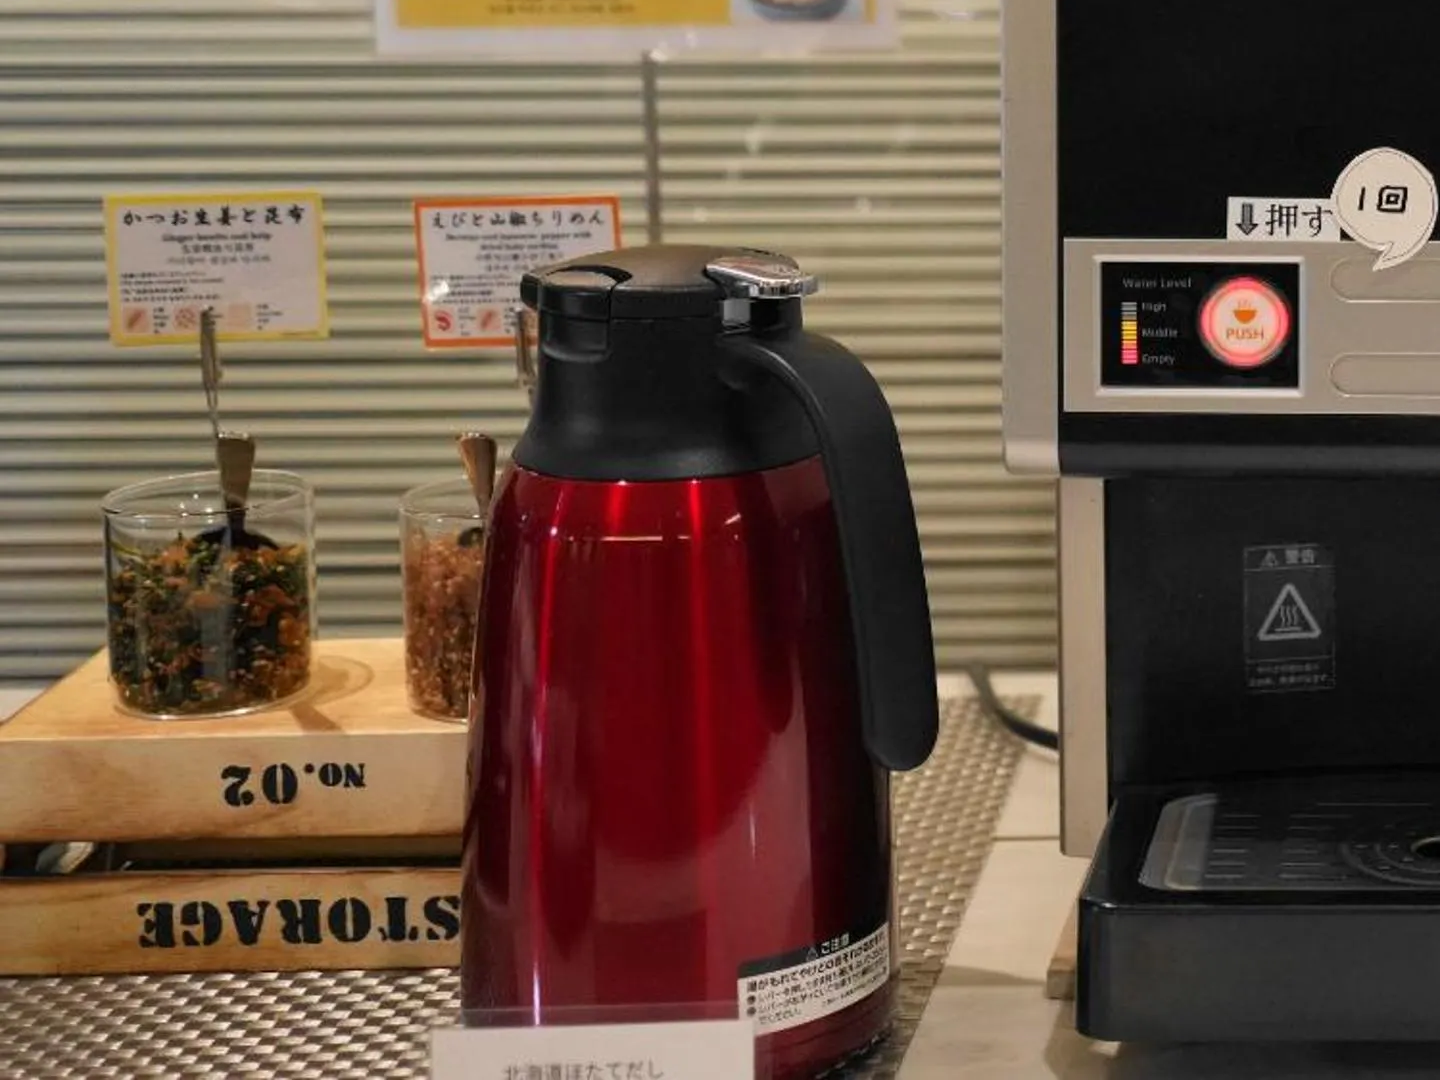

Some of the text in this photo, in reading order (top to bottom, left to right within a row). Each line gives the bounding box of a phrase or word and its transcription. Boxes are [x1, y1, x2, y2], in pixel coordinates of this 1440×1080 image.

[123, 204, 305, 226] かつお生姜と昆布
[1265, 203, 1333, 237] 押す
[1122, 276, 1192, 289] Water Level
[1141, 301, 1167, 313] High
[1141, 327, 1179, 338] Middle
[1225, 327, 1264, 341] PUSH
[1141, 354, 1176, 366] Empty
[137, 895, 461, 949] STORAGE
